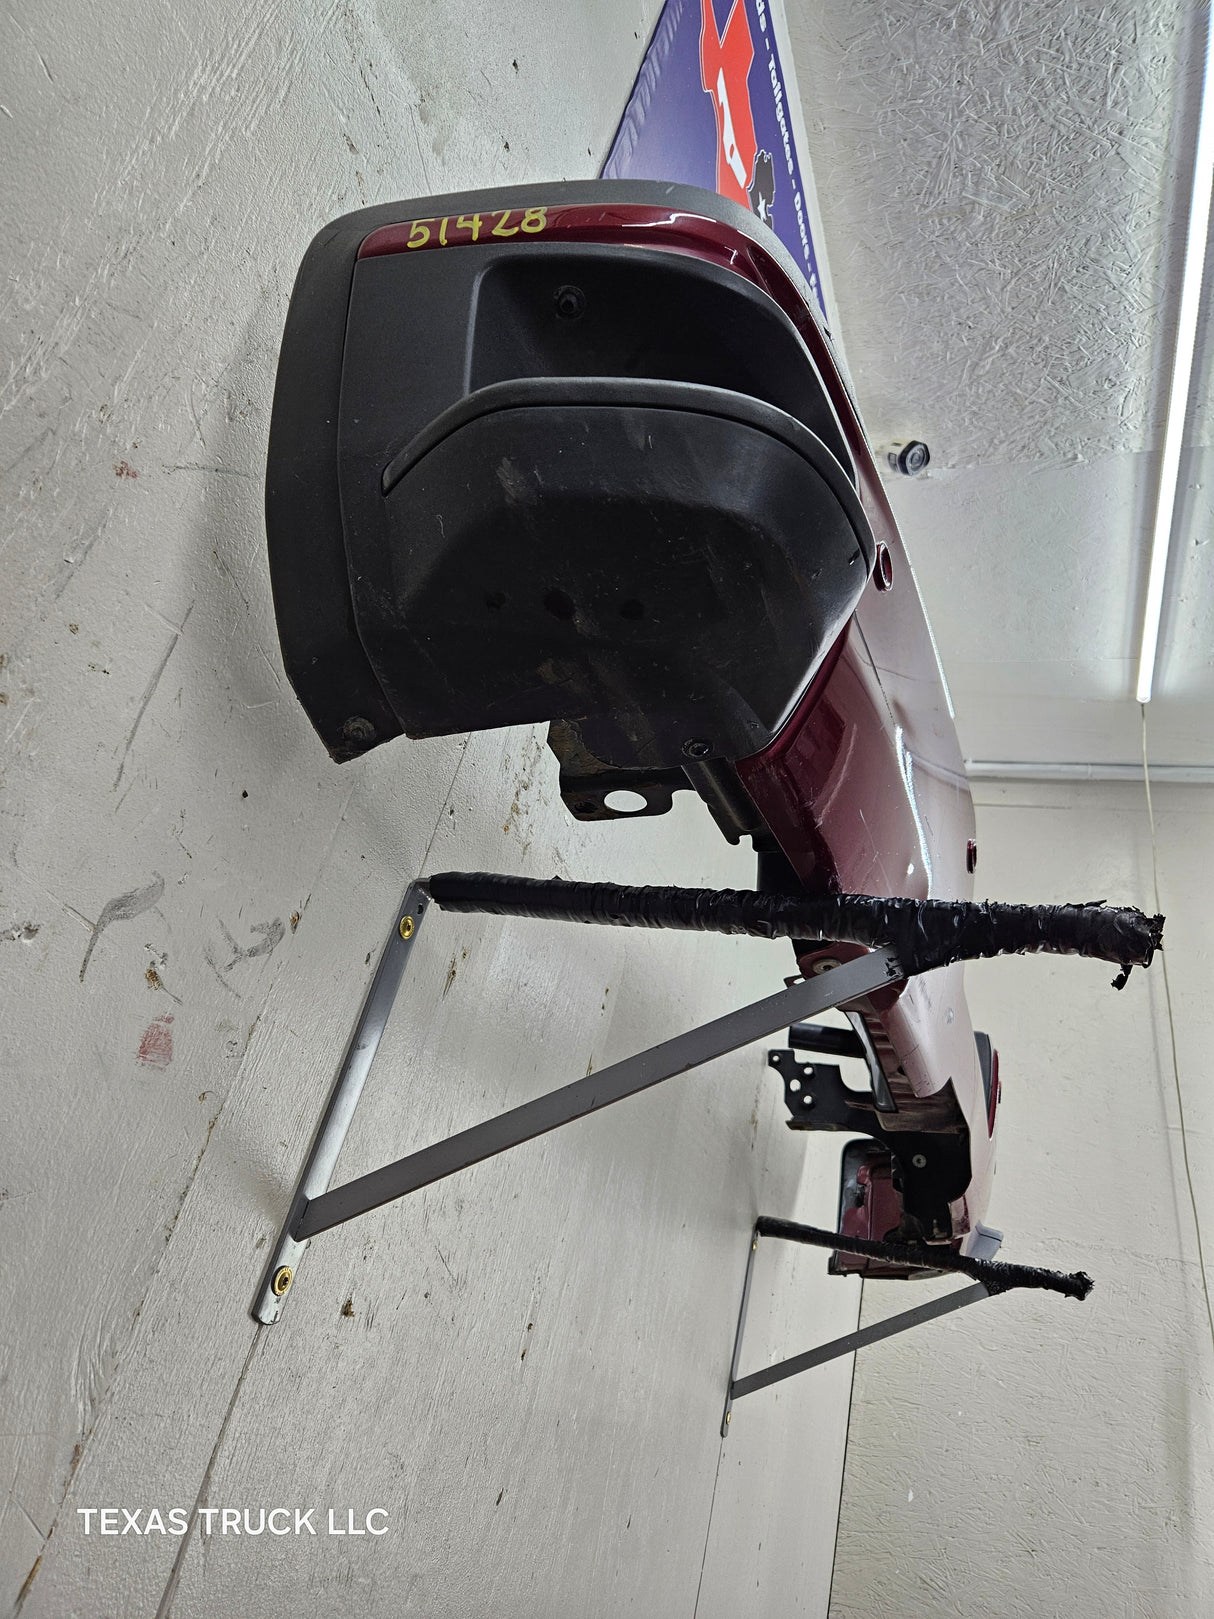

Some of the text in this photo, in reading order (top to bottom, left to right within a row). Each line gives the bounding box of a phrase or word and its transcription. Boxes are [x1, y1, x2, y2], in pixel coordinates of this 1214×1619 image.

[768, 53, 794, 175] Tailgates
[794, 191, 810, 261] Doors
[406, 206, 548, 248] 51428
